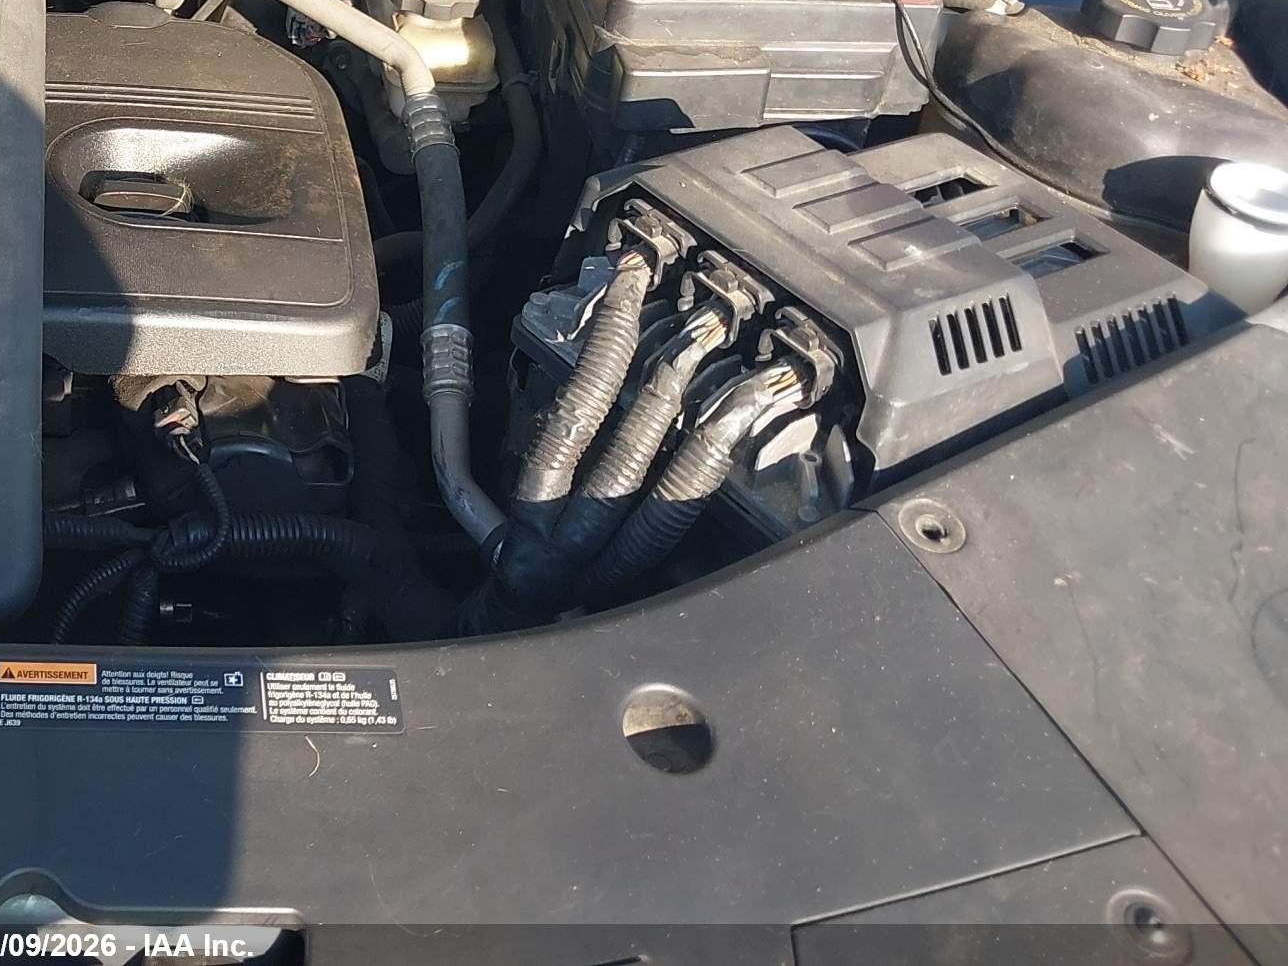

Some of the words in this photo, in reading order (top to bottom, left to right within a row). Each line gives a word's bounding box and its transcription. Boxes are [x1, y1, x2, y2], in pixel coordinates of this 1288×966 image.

[17, 670, 88, 679] AVERTISSEMENT
[170, 672, 193, 681] Risque
[194, 680, 209, 688] peut
[1, 694, 26, 702] FLUIDE
[77, 695, 103, 703] R-134a
[104, 695, 124, 703] SOUS
[126, 695, 149, 704] HAUTE
[151, 696, 187, 704] PRESSION
[159, 705, 193, 714] personnel
[194, 706, 219, 715] qualifié
[220, 706, 258, 714] seulement.
[15, 711, 49, 719] méthodes
[88, 712, 126, 720] incorrectes
[127, 713, 154, 722] peuvent
[194, 714, 228, 722] blessures.
